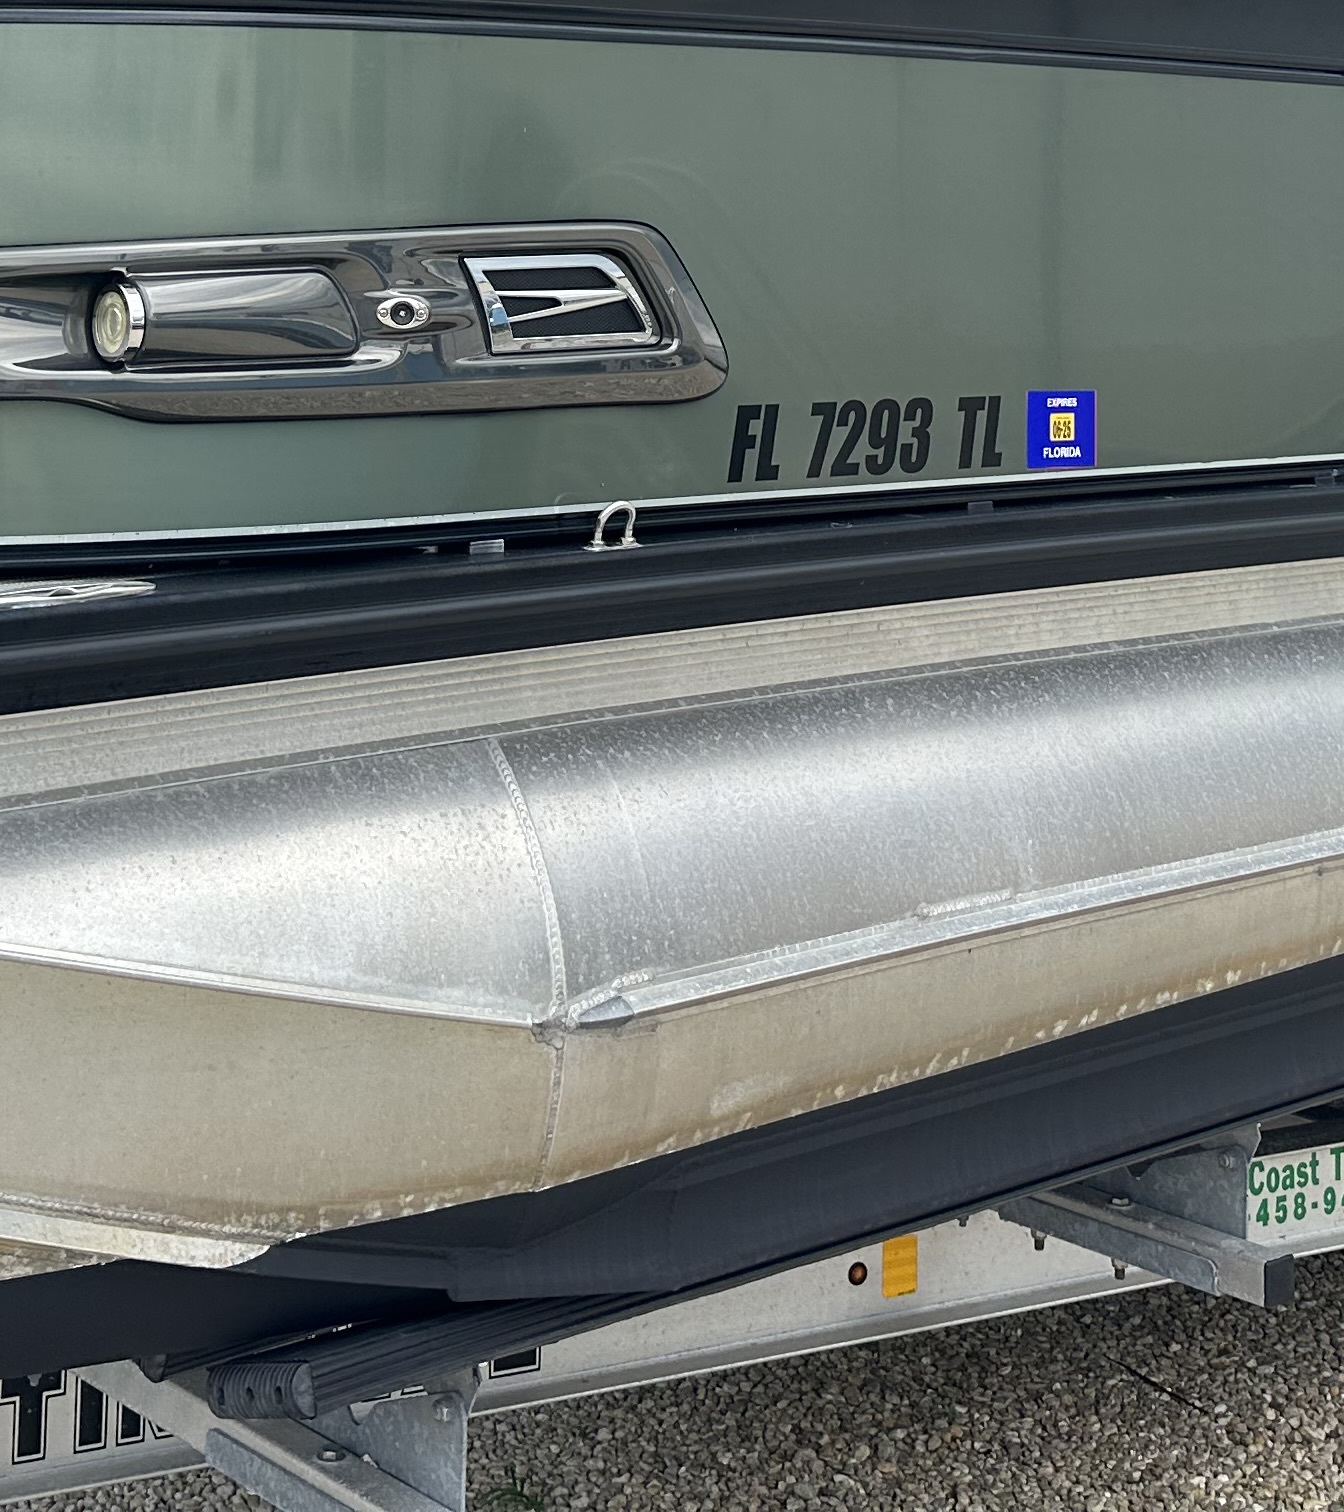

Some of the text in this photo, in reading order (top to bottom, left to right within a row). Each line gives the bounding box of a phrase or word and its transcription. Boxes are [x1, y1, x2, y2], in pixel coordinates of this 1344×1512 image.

[1047, 398, 1077, 407] EXPIRES
[727, 395, 1003, 483] FL 7293 TL
[1043, 446, 1081, 458] FLORIDA
[1248, 1152, 1319, 1196] Coast
